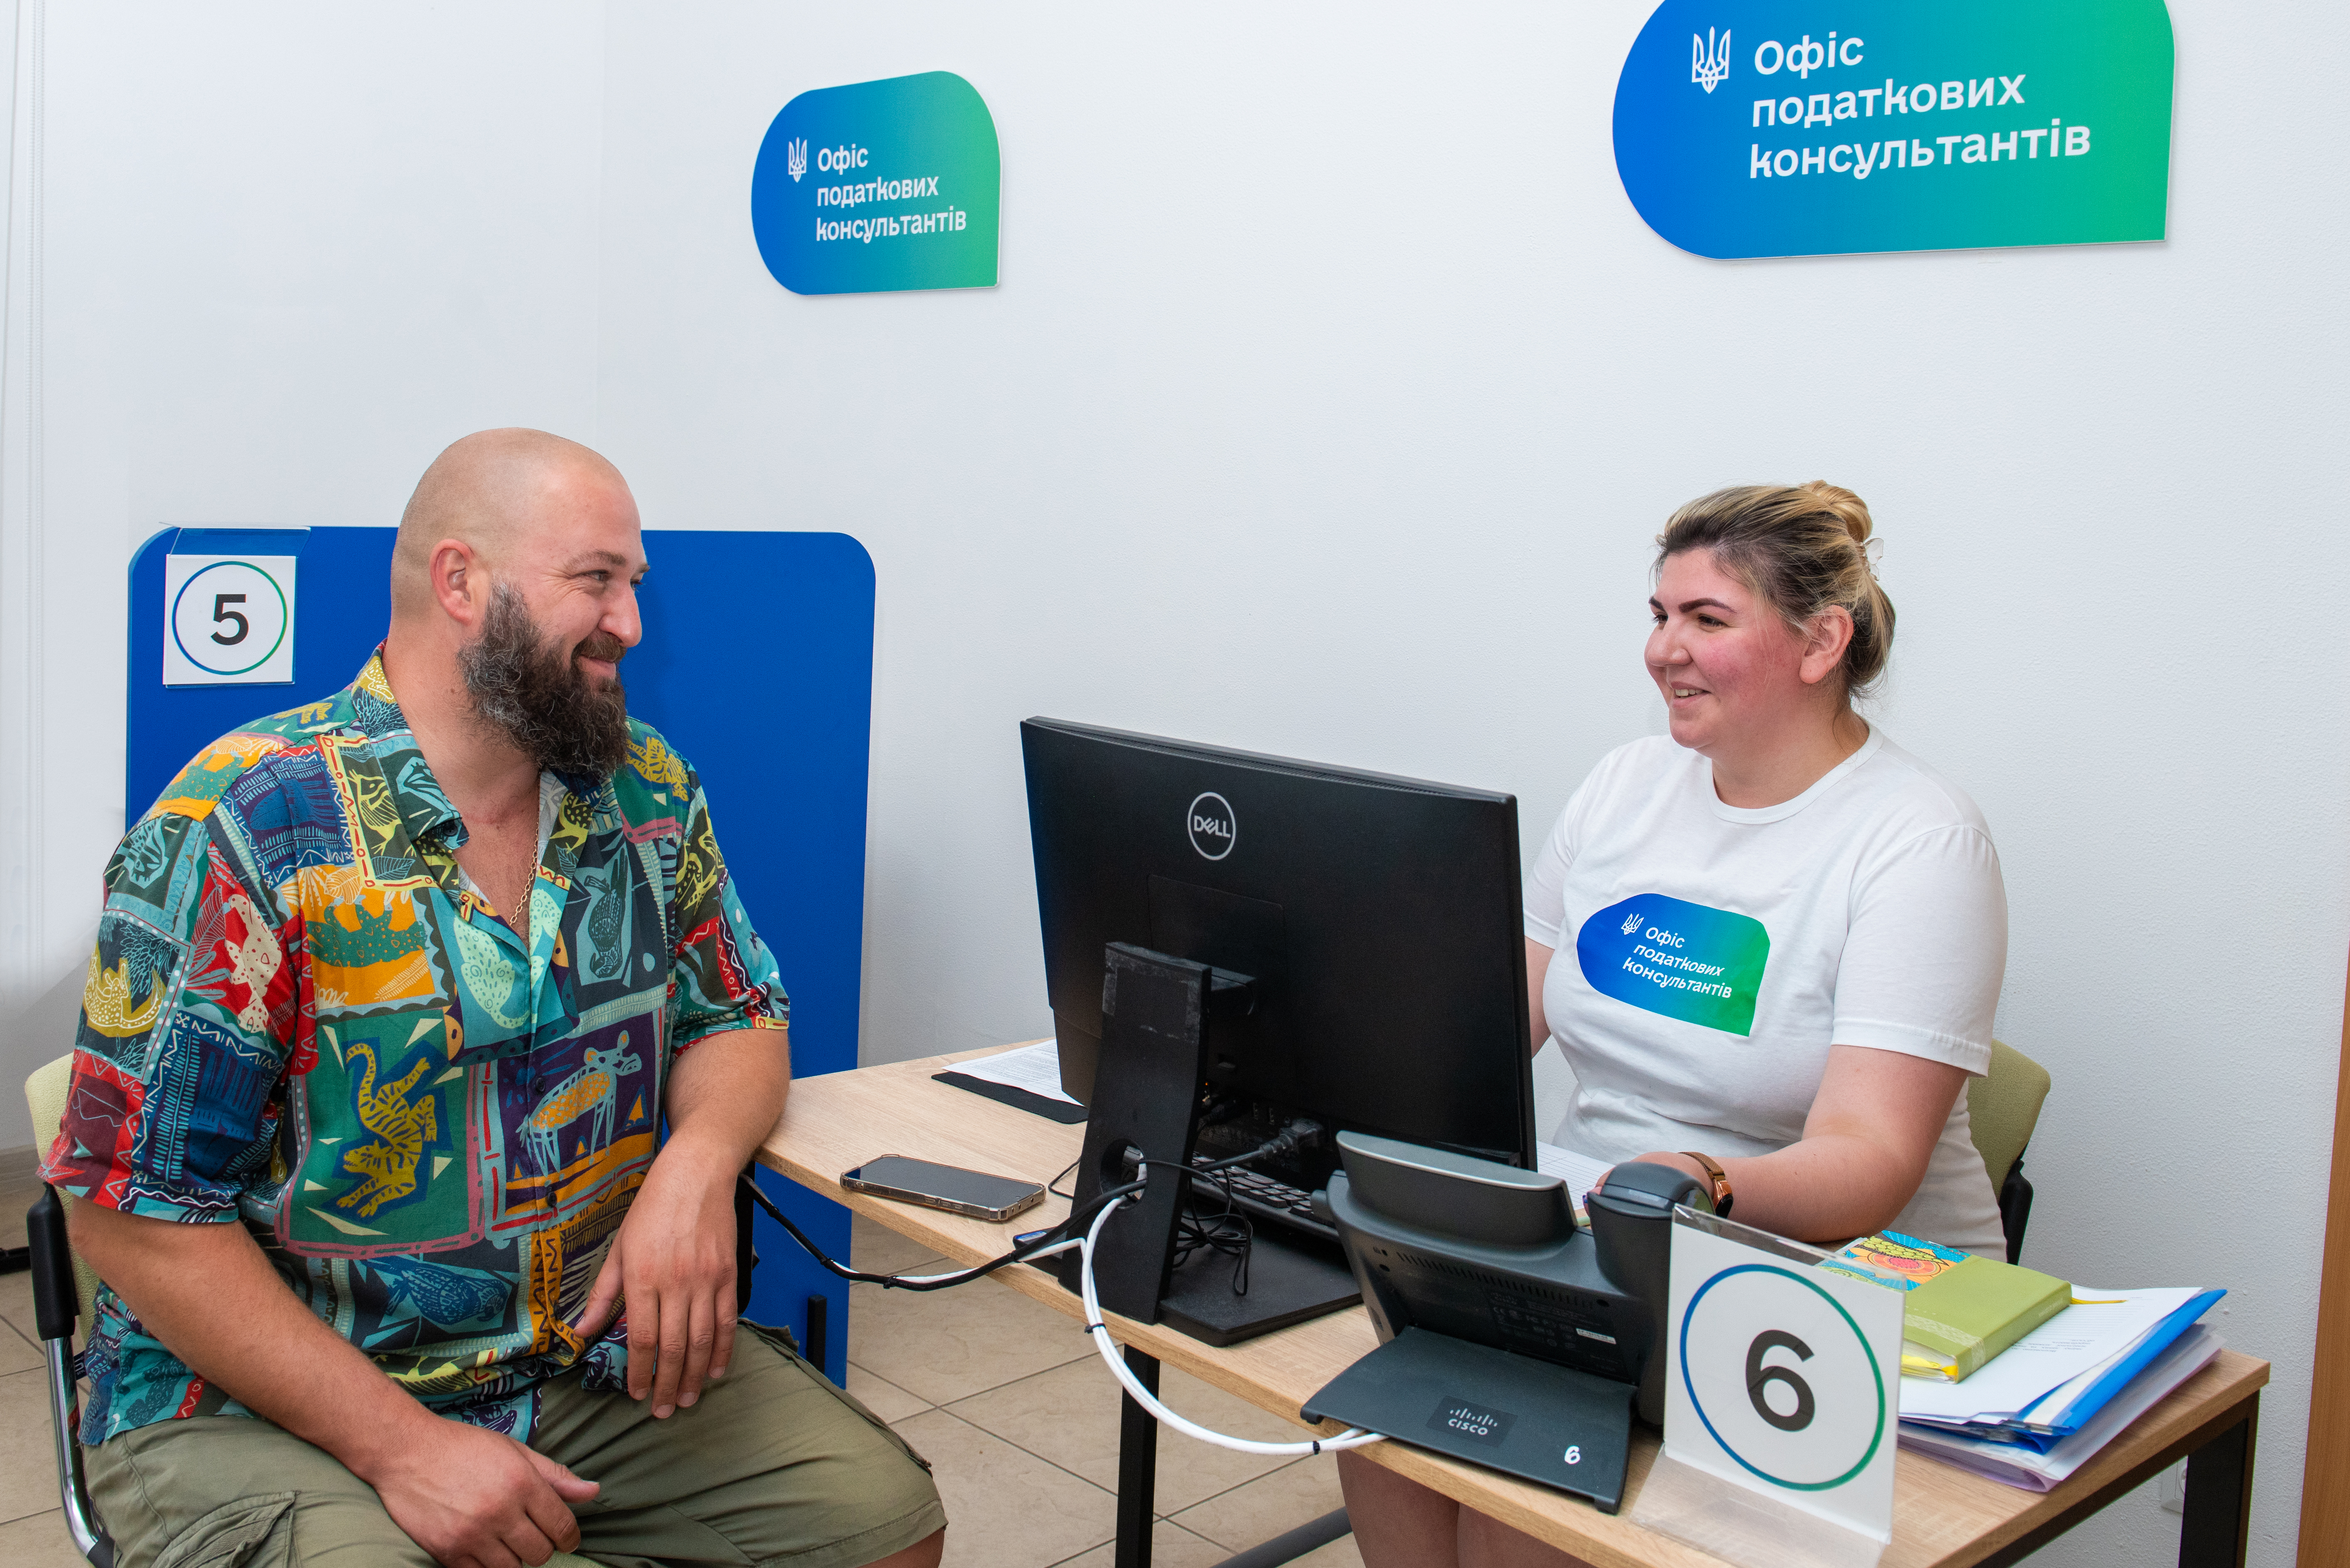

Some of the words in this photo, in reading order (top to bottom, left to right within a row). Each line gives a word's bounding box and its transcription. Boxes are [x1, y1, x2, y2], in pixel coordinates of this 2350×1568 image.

[1755, 31, 1864, 79] Офіс
[1753, 74, 2026, 128] податкових
[817, 143, 868, 175] Офіс
[1750, 118, 2090, 180] консультантів
[817, 176, 939, 208] податкових
[816, 205, 966, 244] консультантів
[211, 594, 248, 646] 5
[1193, 815, 1231, 838] DELL
[1646, 927, 1685, 948] Офіс
[1622, 957, 1732, 998] консультантів
[1633, 944, 1725, 976] податкових
[1745, 1330, 1815, 1432] 6
[1564, 1446, 1581, 1465] 6
